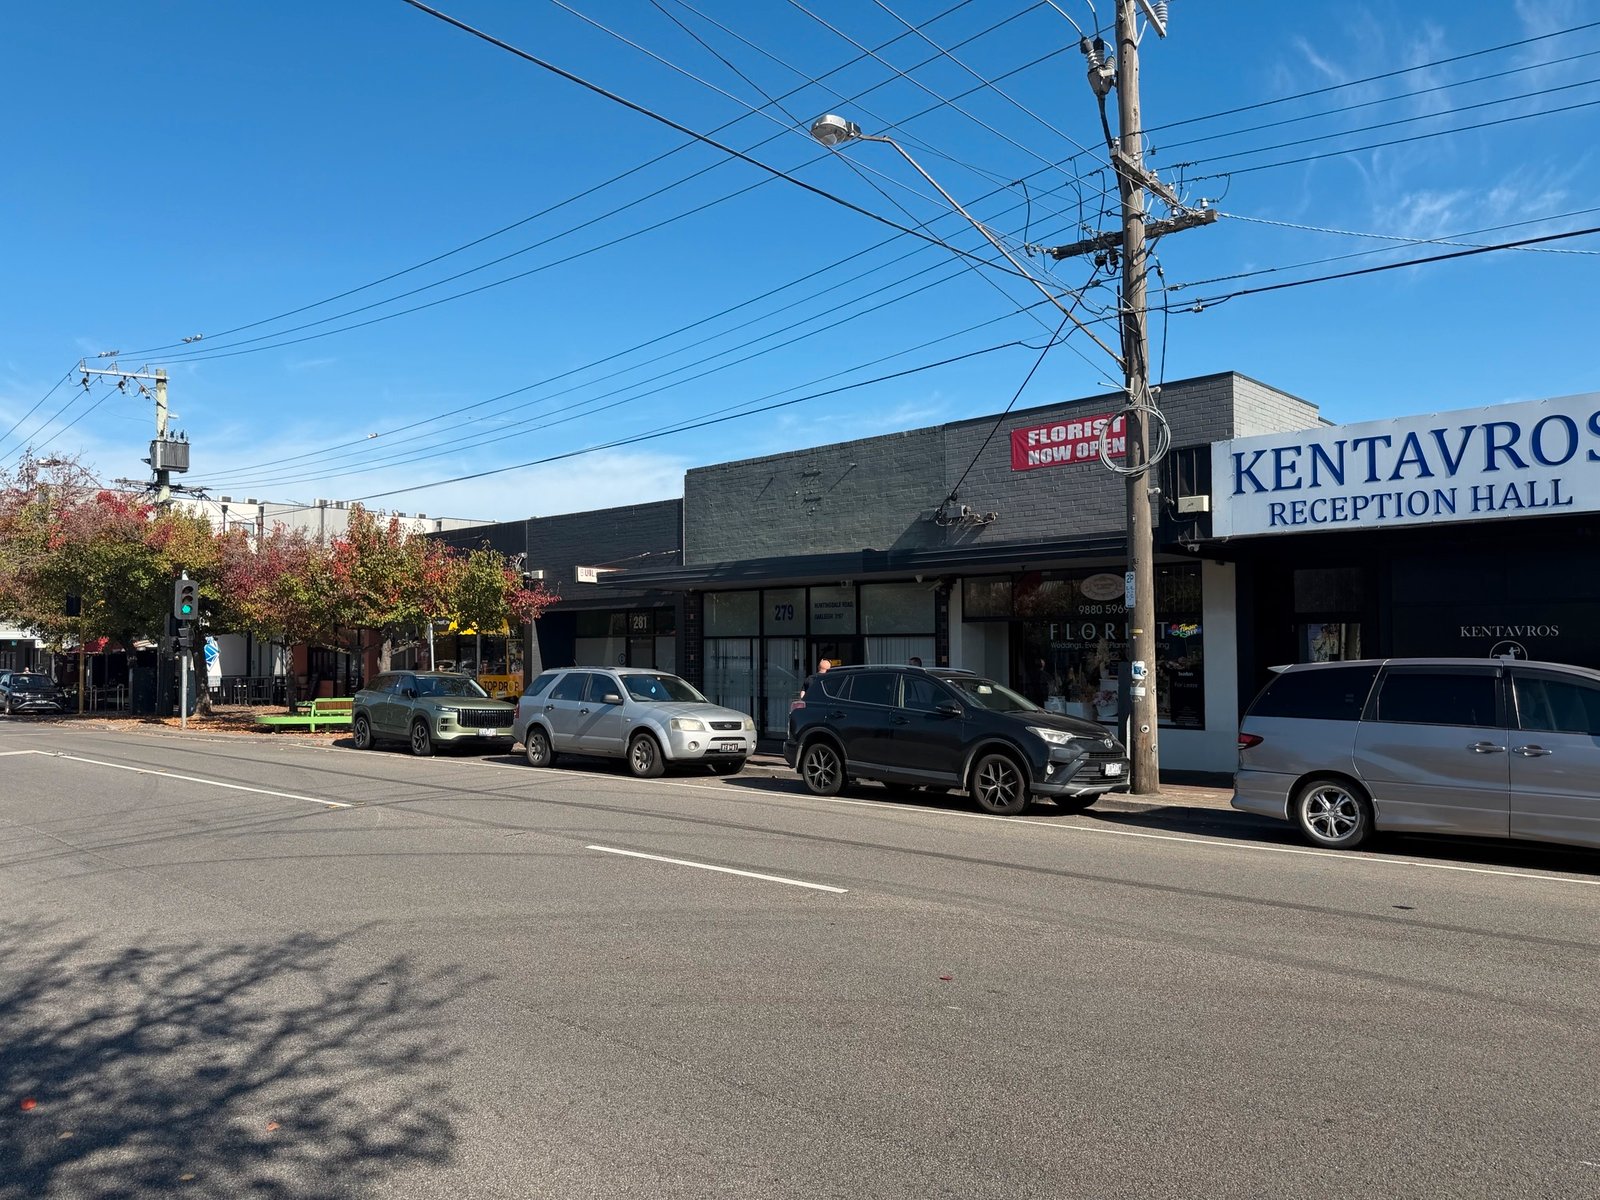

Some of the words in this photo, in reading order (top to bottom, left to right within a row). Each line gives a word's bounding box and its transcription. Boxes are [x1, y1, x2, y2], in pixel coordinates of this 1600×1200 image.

[1028, 415, 1125, 447] FLORIST
[1028, 444, 1072, 466] NOW
[1076, 436, 1126, 458] OPEN
[1269, 488, 1458, 526] RECEPTION
[1471, 478, 1573, 511] HALL
[774, 603, 794, 621] 279
[1078, 604, 1103, 615] 9880
[633, 616, 647, 629] 281
[1050, 621, 1170, 640] FLORIT
[1460, 624, 1560, 638] KENTAVROS
[484, 681, 498, 691] TOP
[498, 681, 520, 692] DROP
